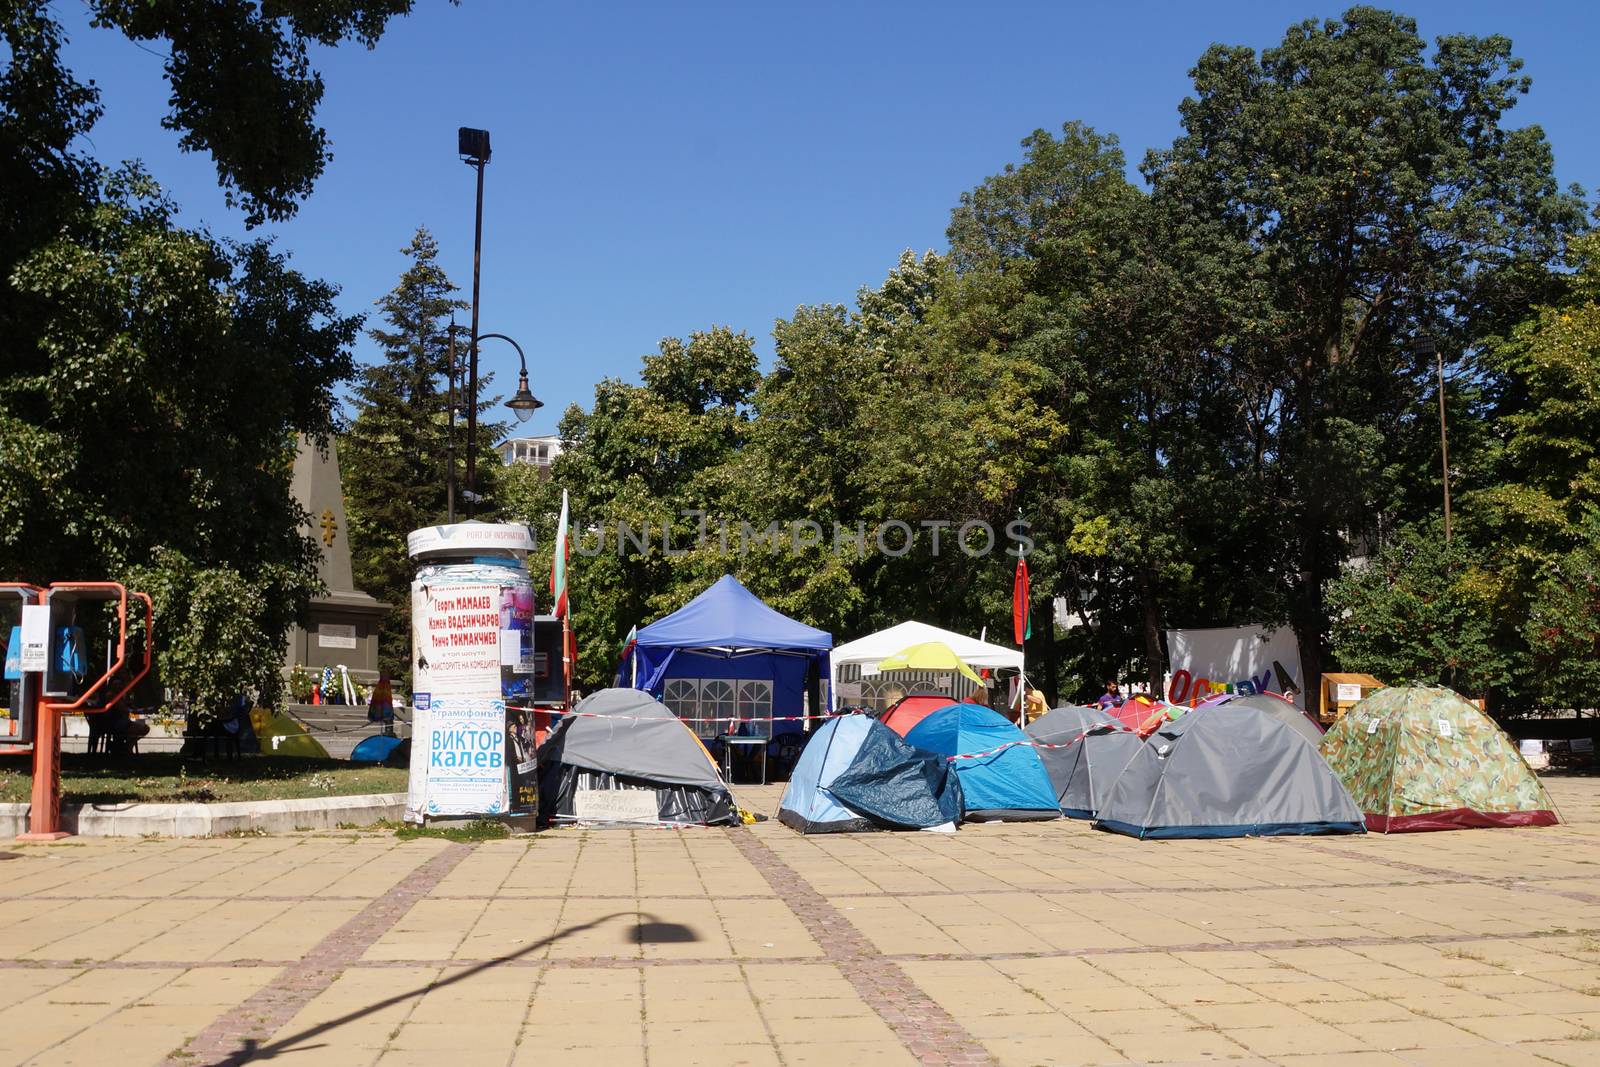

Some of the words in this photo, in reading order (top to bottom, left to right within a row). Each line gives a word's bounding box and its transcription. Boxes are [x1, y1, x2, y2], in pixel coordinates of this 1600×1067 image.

[456, 596, 491, 611] МАМАЛЕВ
[447, 613, 500, 631] ВОДЕНИЧАРОВ
[450, 631, 497, 647] ТОКМАКЧИЕВ
[431, 730, 503, 751] ВИКТОР
[431, 751, 502, 769] калев
